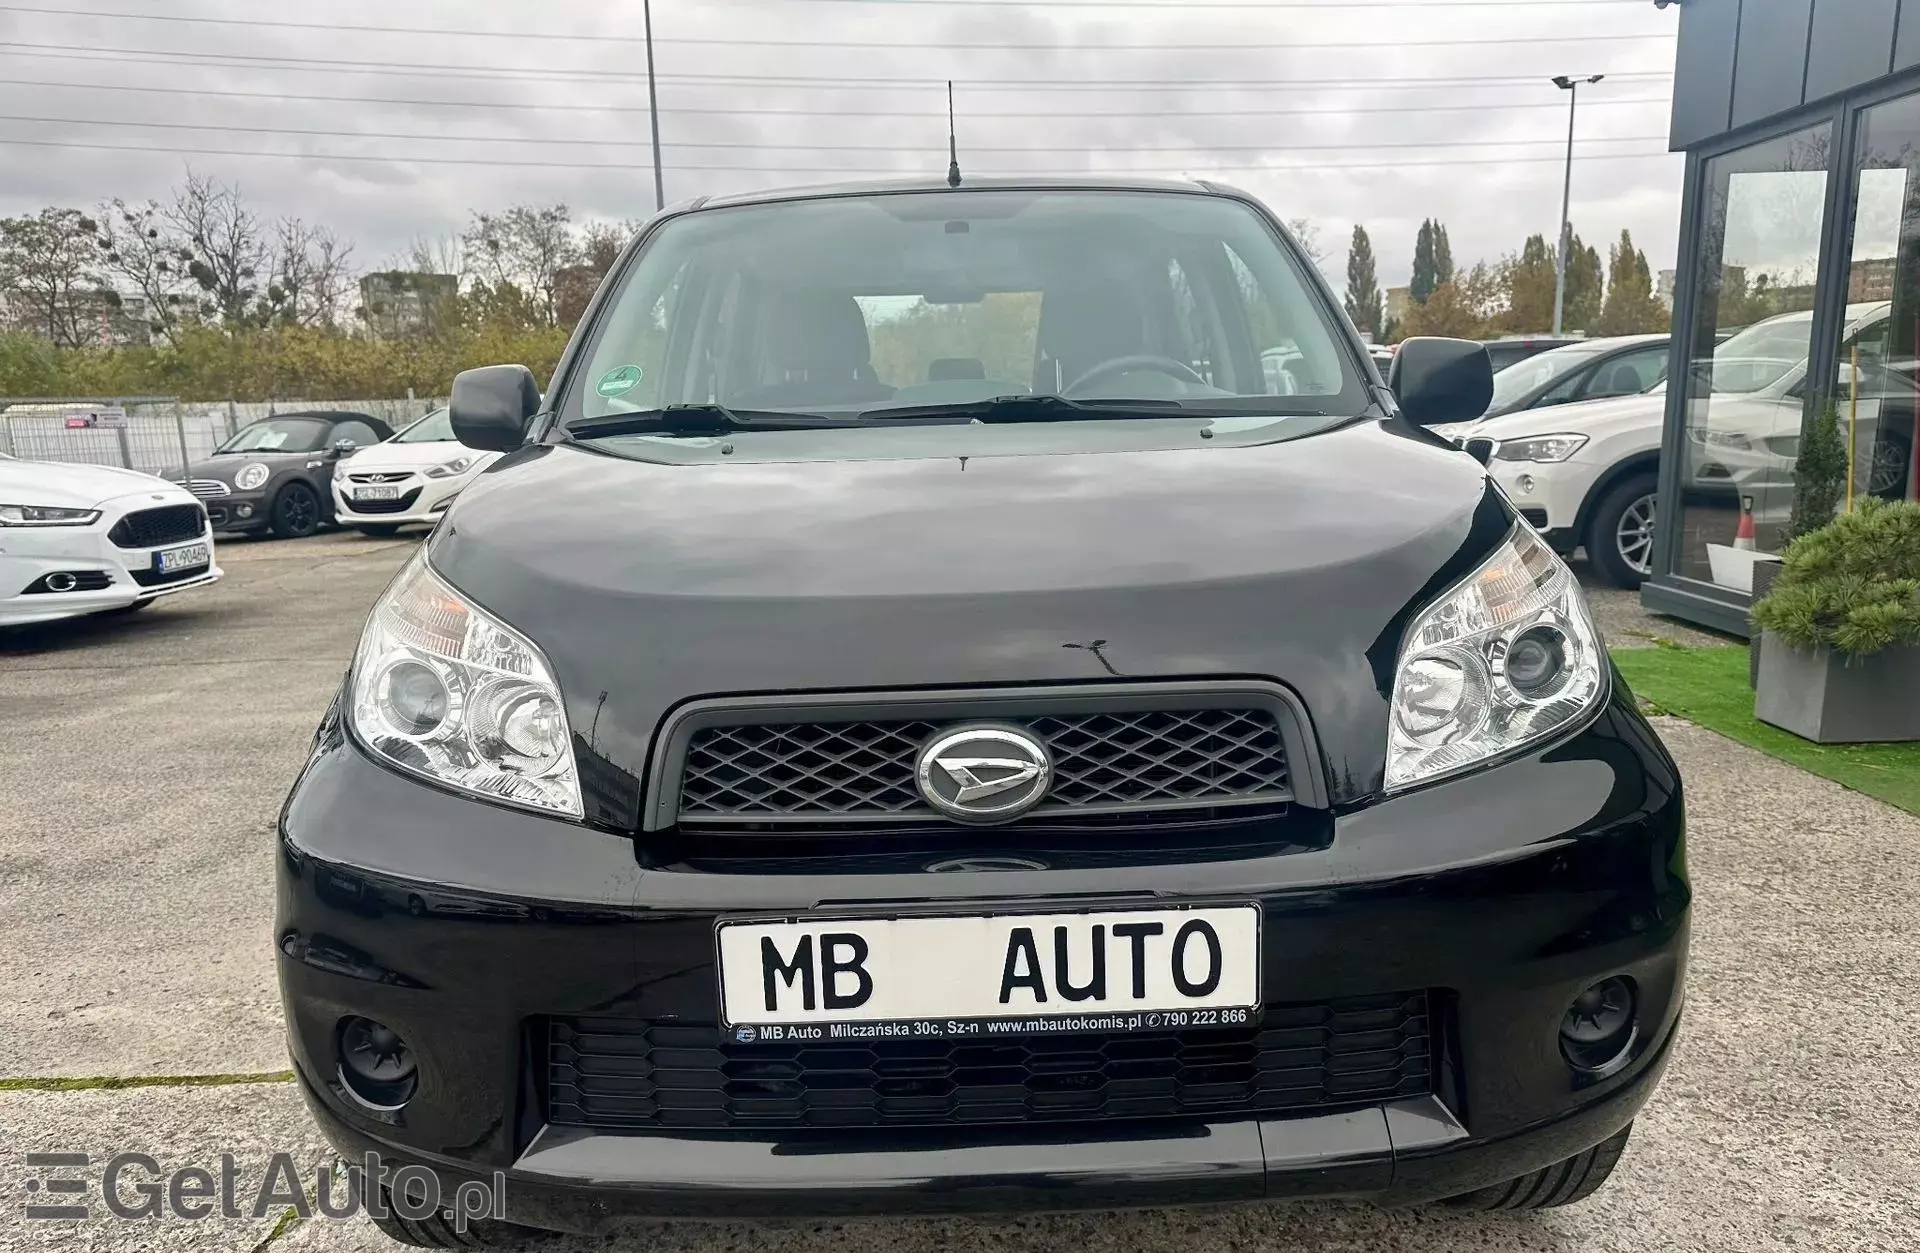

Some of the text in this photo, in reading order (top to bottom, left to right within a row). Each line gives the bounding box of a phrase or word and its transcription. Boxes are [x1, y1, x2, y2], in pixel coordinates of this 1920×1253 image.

[162, 546, 206, 568] ZPL 90469
[760, 918, 1223, 1011] MB AUTO
[760, 1008, 1247, 1040] MB Auto Milczańska 30c, Sz-n www.mbautokomis.pl 790 222 866
